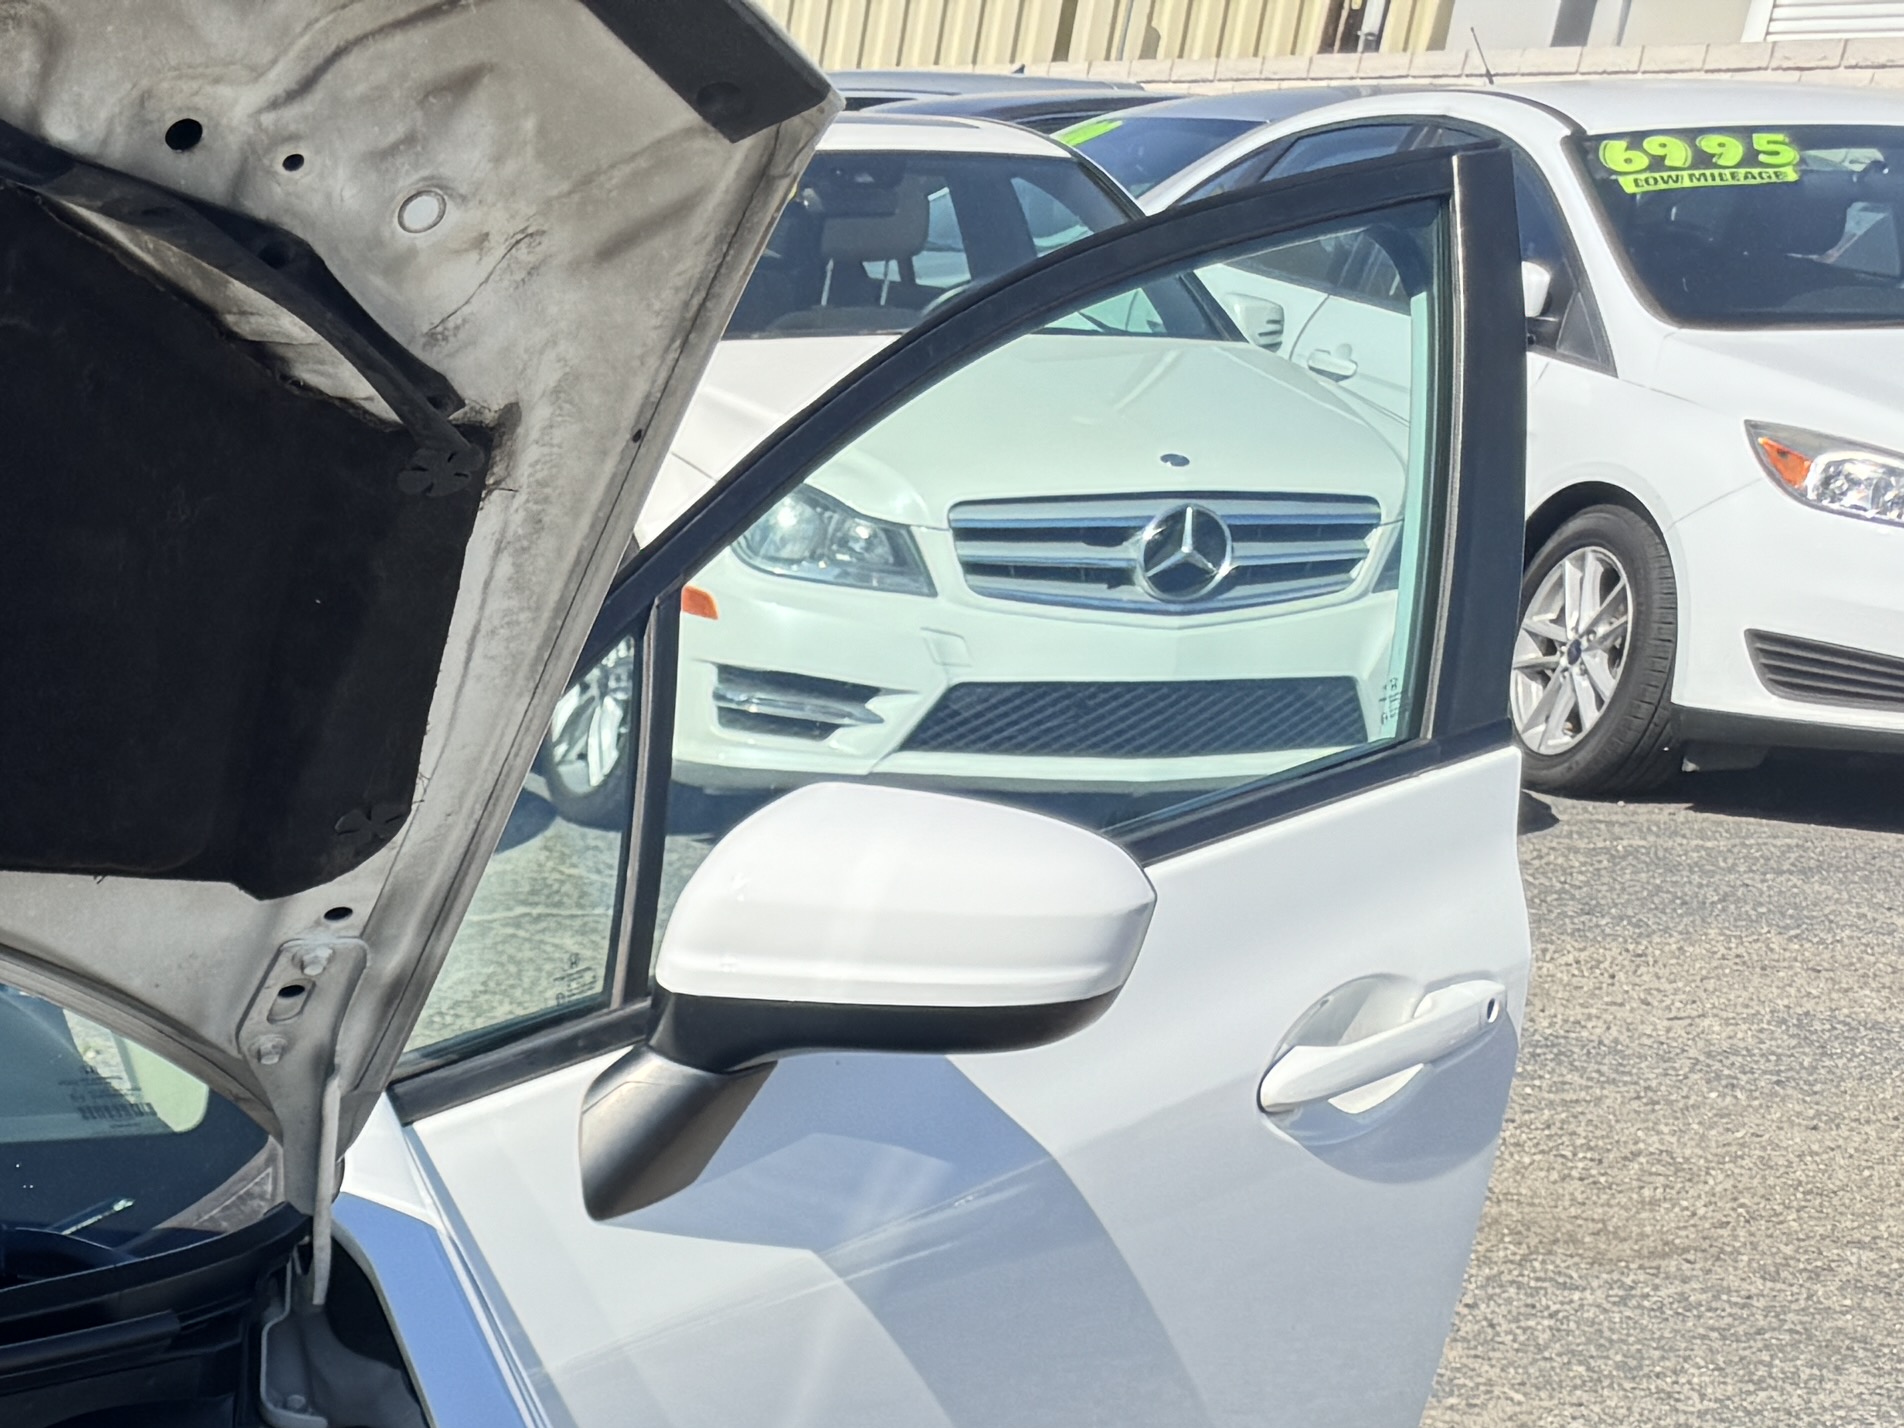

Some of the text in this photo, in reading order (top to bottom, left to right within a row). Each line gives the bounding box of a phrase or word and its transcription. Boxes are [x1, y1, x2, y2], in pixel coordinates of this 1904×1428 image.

[1598, 133, 1800, 172] 6995
[1633, 171, 1788, 188] LOW MILEAGE
